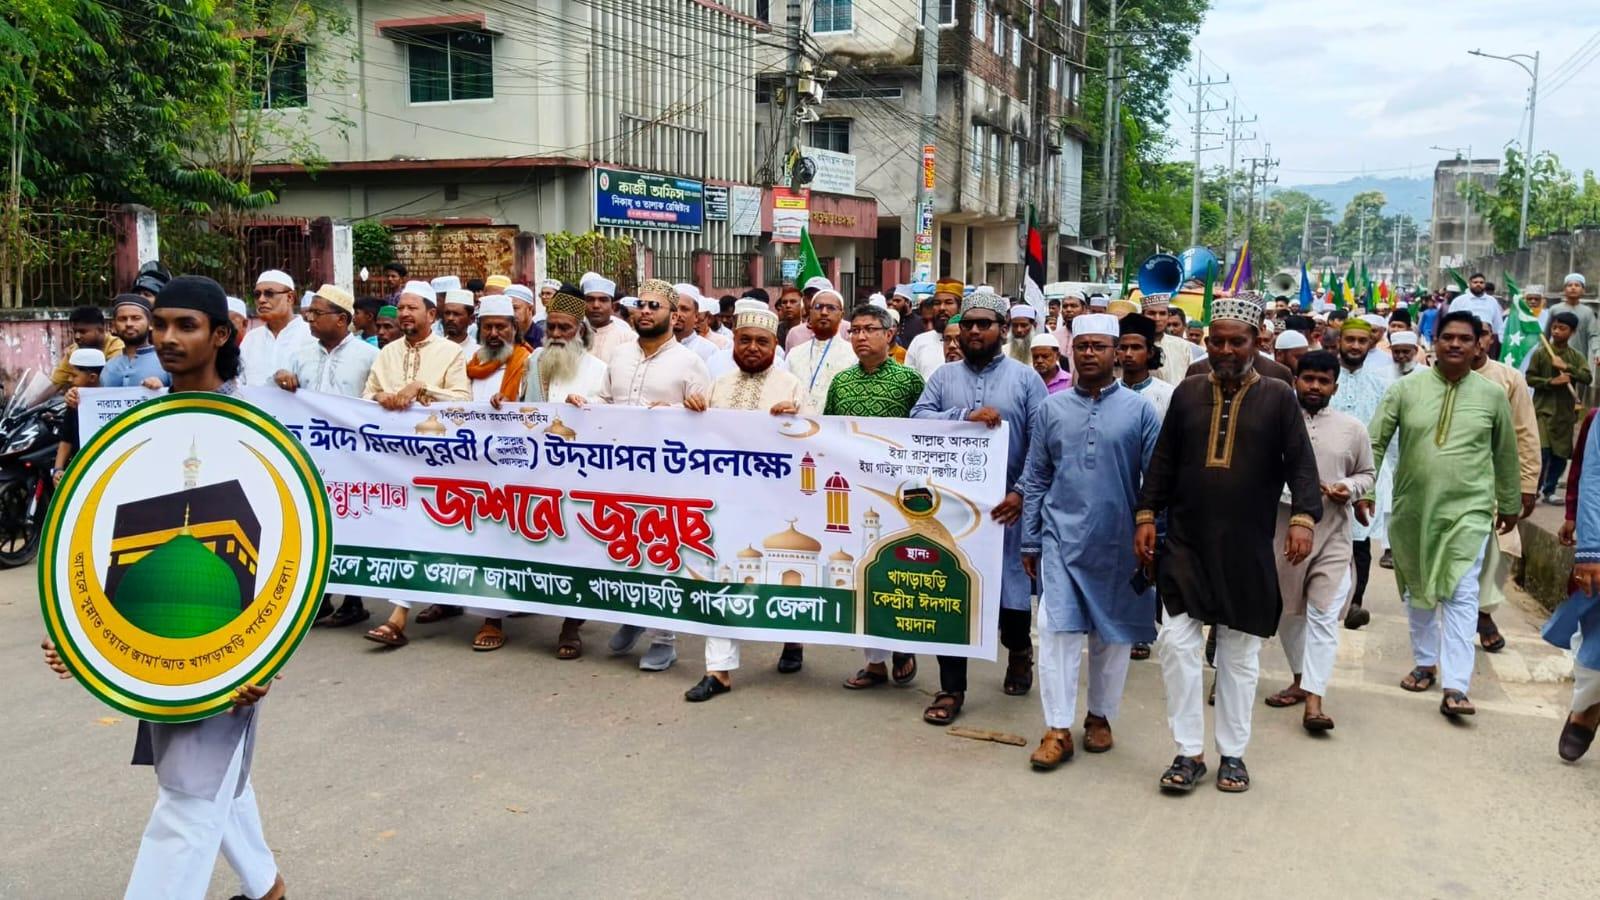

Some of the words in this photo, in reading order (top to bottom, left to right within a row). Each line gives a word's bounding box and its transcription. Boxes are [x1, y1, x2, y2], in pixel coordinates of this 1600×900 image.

[618, 179, 647, 196] কাজী
[650, 183, 684, 200] অফিস
[635, 200, 641, 208] ও
[309, 418, 356, 451] ঈদে
[359, 424, 478, 467] মিলাদুন্নবী
[662, 439, 793, 479] উপলক্ষে
[949, 436, 990, 448] আকবার
[889, 446, 907, 461] ইয়া
[859, 460, 873, 474] ইয়া
[906, 465, 929, 476] আজম
[412, 476, 565, 542] জশনে
[569, 489, 717, 572] জুলুছ
[366, 556, 418, 585] সুন্নাত
[424, 562, 478, 587] ওয়াল
[588, 577, 684, 614] খাগড়াছড়ি
[690, 585, 759, 618] পার্বত্য
[888, 569, 948, 592] খাগড়াছড়ি
[74, 551, 88, 594] আহলে
[81, 595, 104, 628] সুন্নাত
[103, 628, 131, 655] ওয়াল
[189, 633, 245, 668] খাগড়াছড়ি
[245, 601, 277, 636] পার্বত্য
[872, 588, 915, 610] কেন্দ্রীয়
[918, 592, 962, 614] ঈদগাহ
[895, 616, 936, 634] ময়দান
